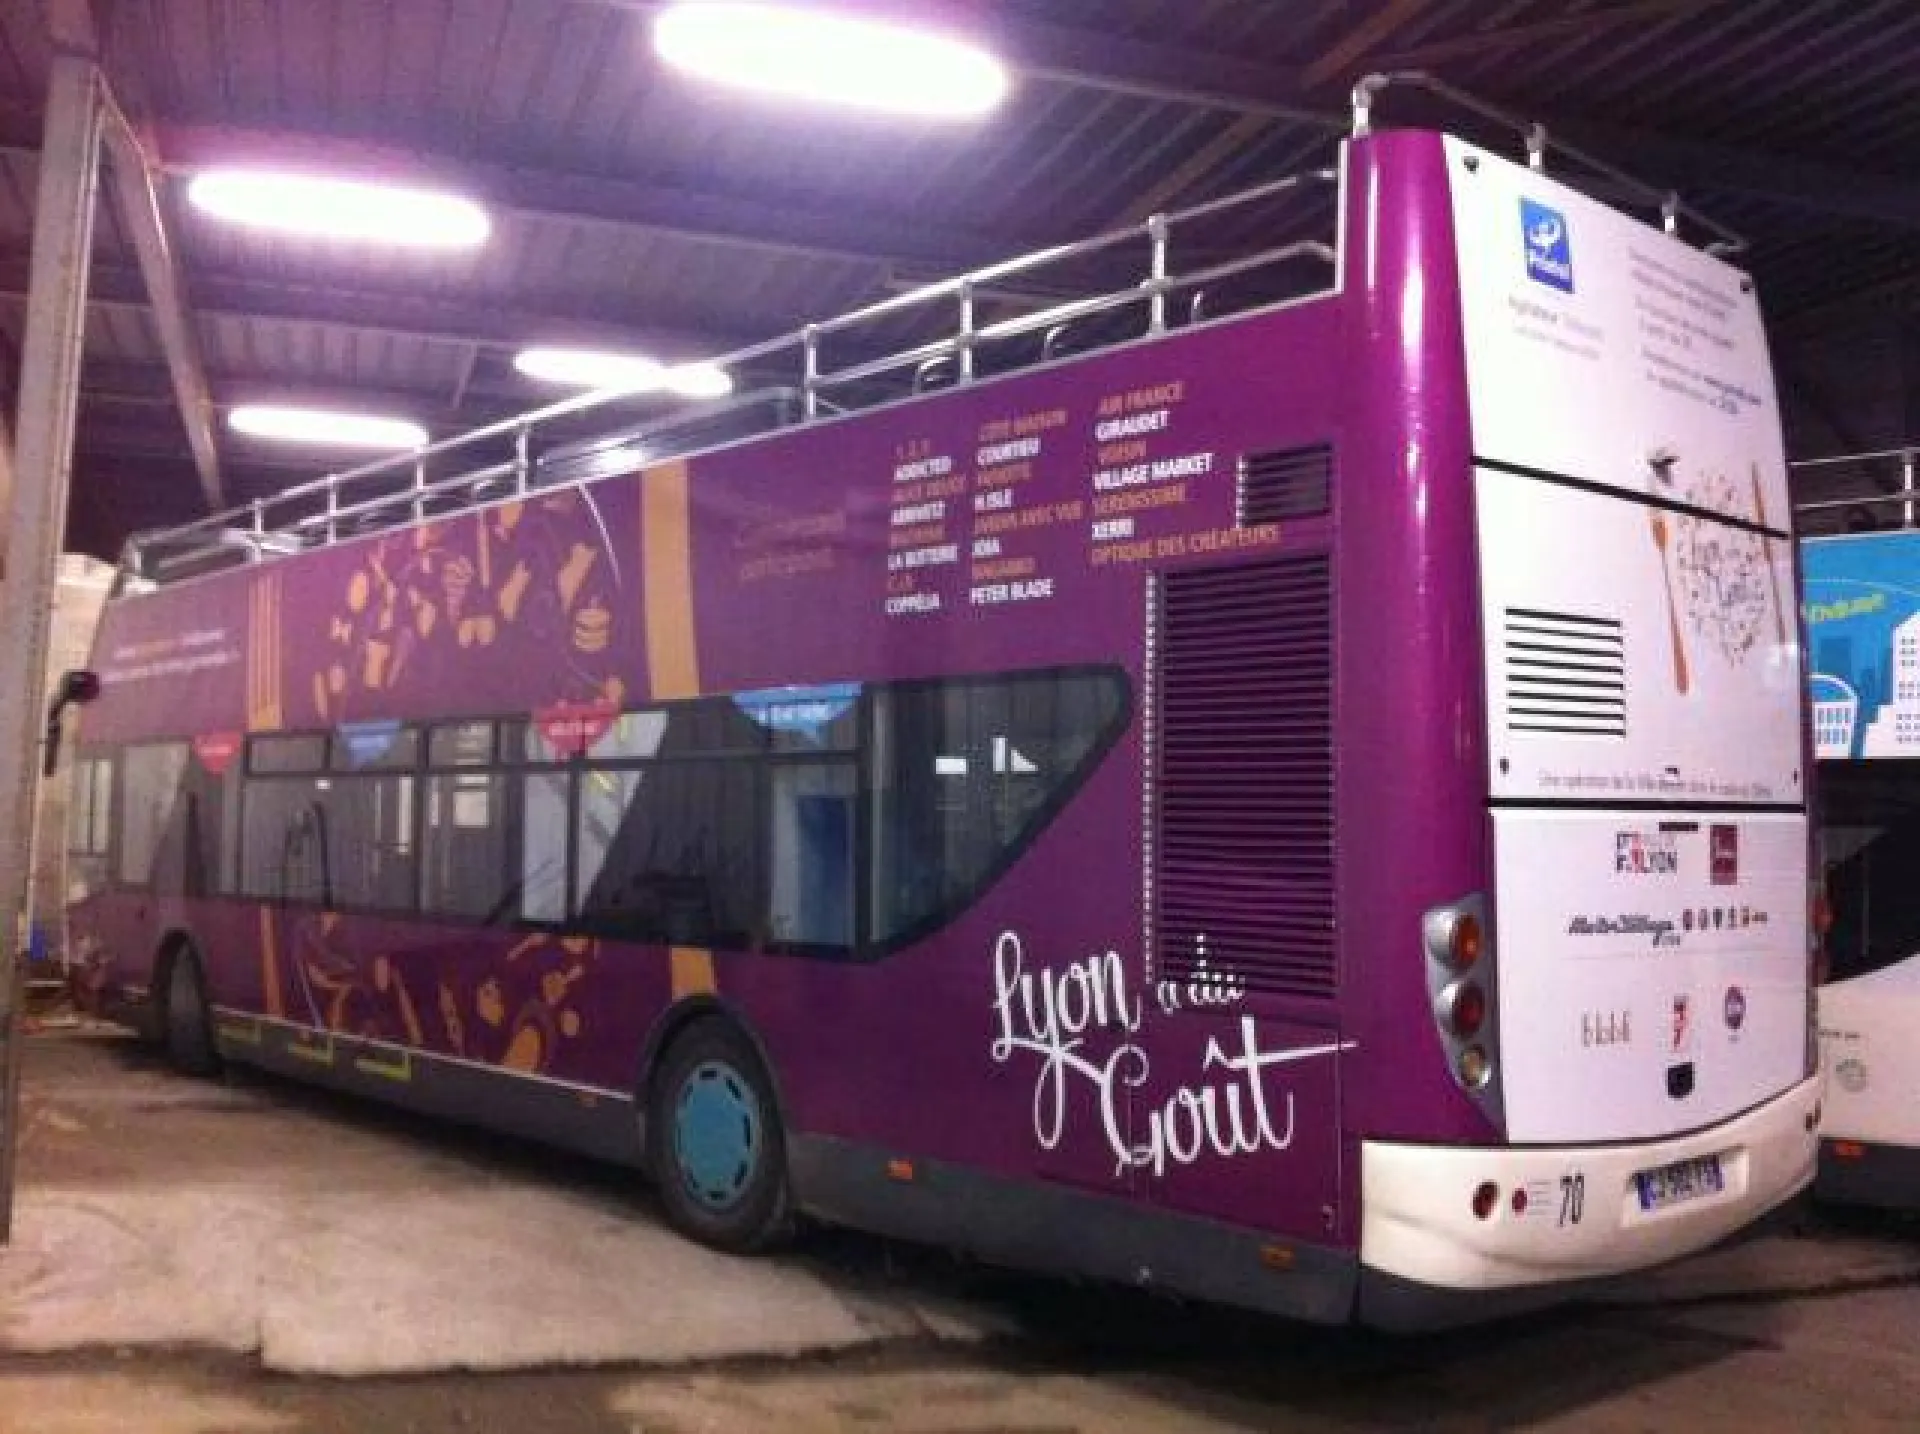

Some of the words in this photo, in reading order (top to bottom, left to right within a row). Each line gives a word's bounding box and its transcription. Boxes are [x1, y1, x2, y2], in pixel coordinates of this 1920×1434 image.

[1096, 411, 1169, 441] GIRAUDET
[1094, 464, 1149, 490] VILLAGE
[1152, 452, 1213, 480] MARKET
[969, 584, 1008, 604] PETER
[1010, 578, 1054, 600] BLADE
[991, 930, 1142, 1150] Lyon
[1100, 1015, 1359, 1177] Goût
[1557, 1172, 1585, 1228] 70
